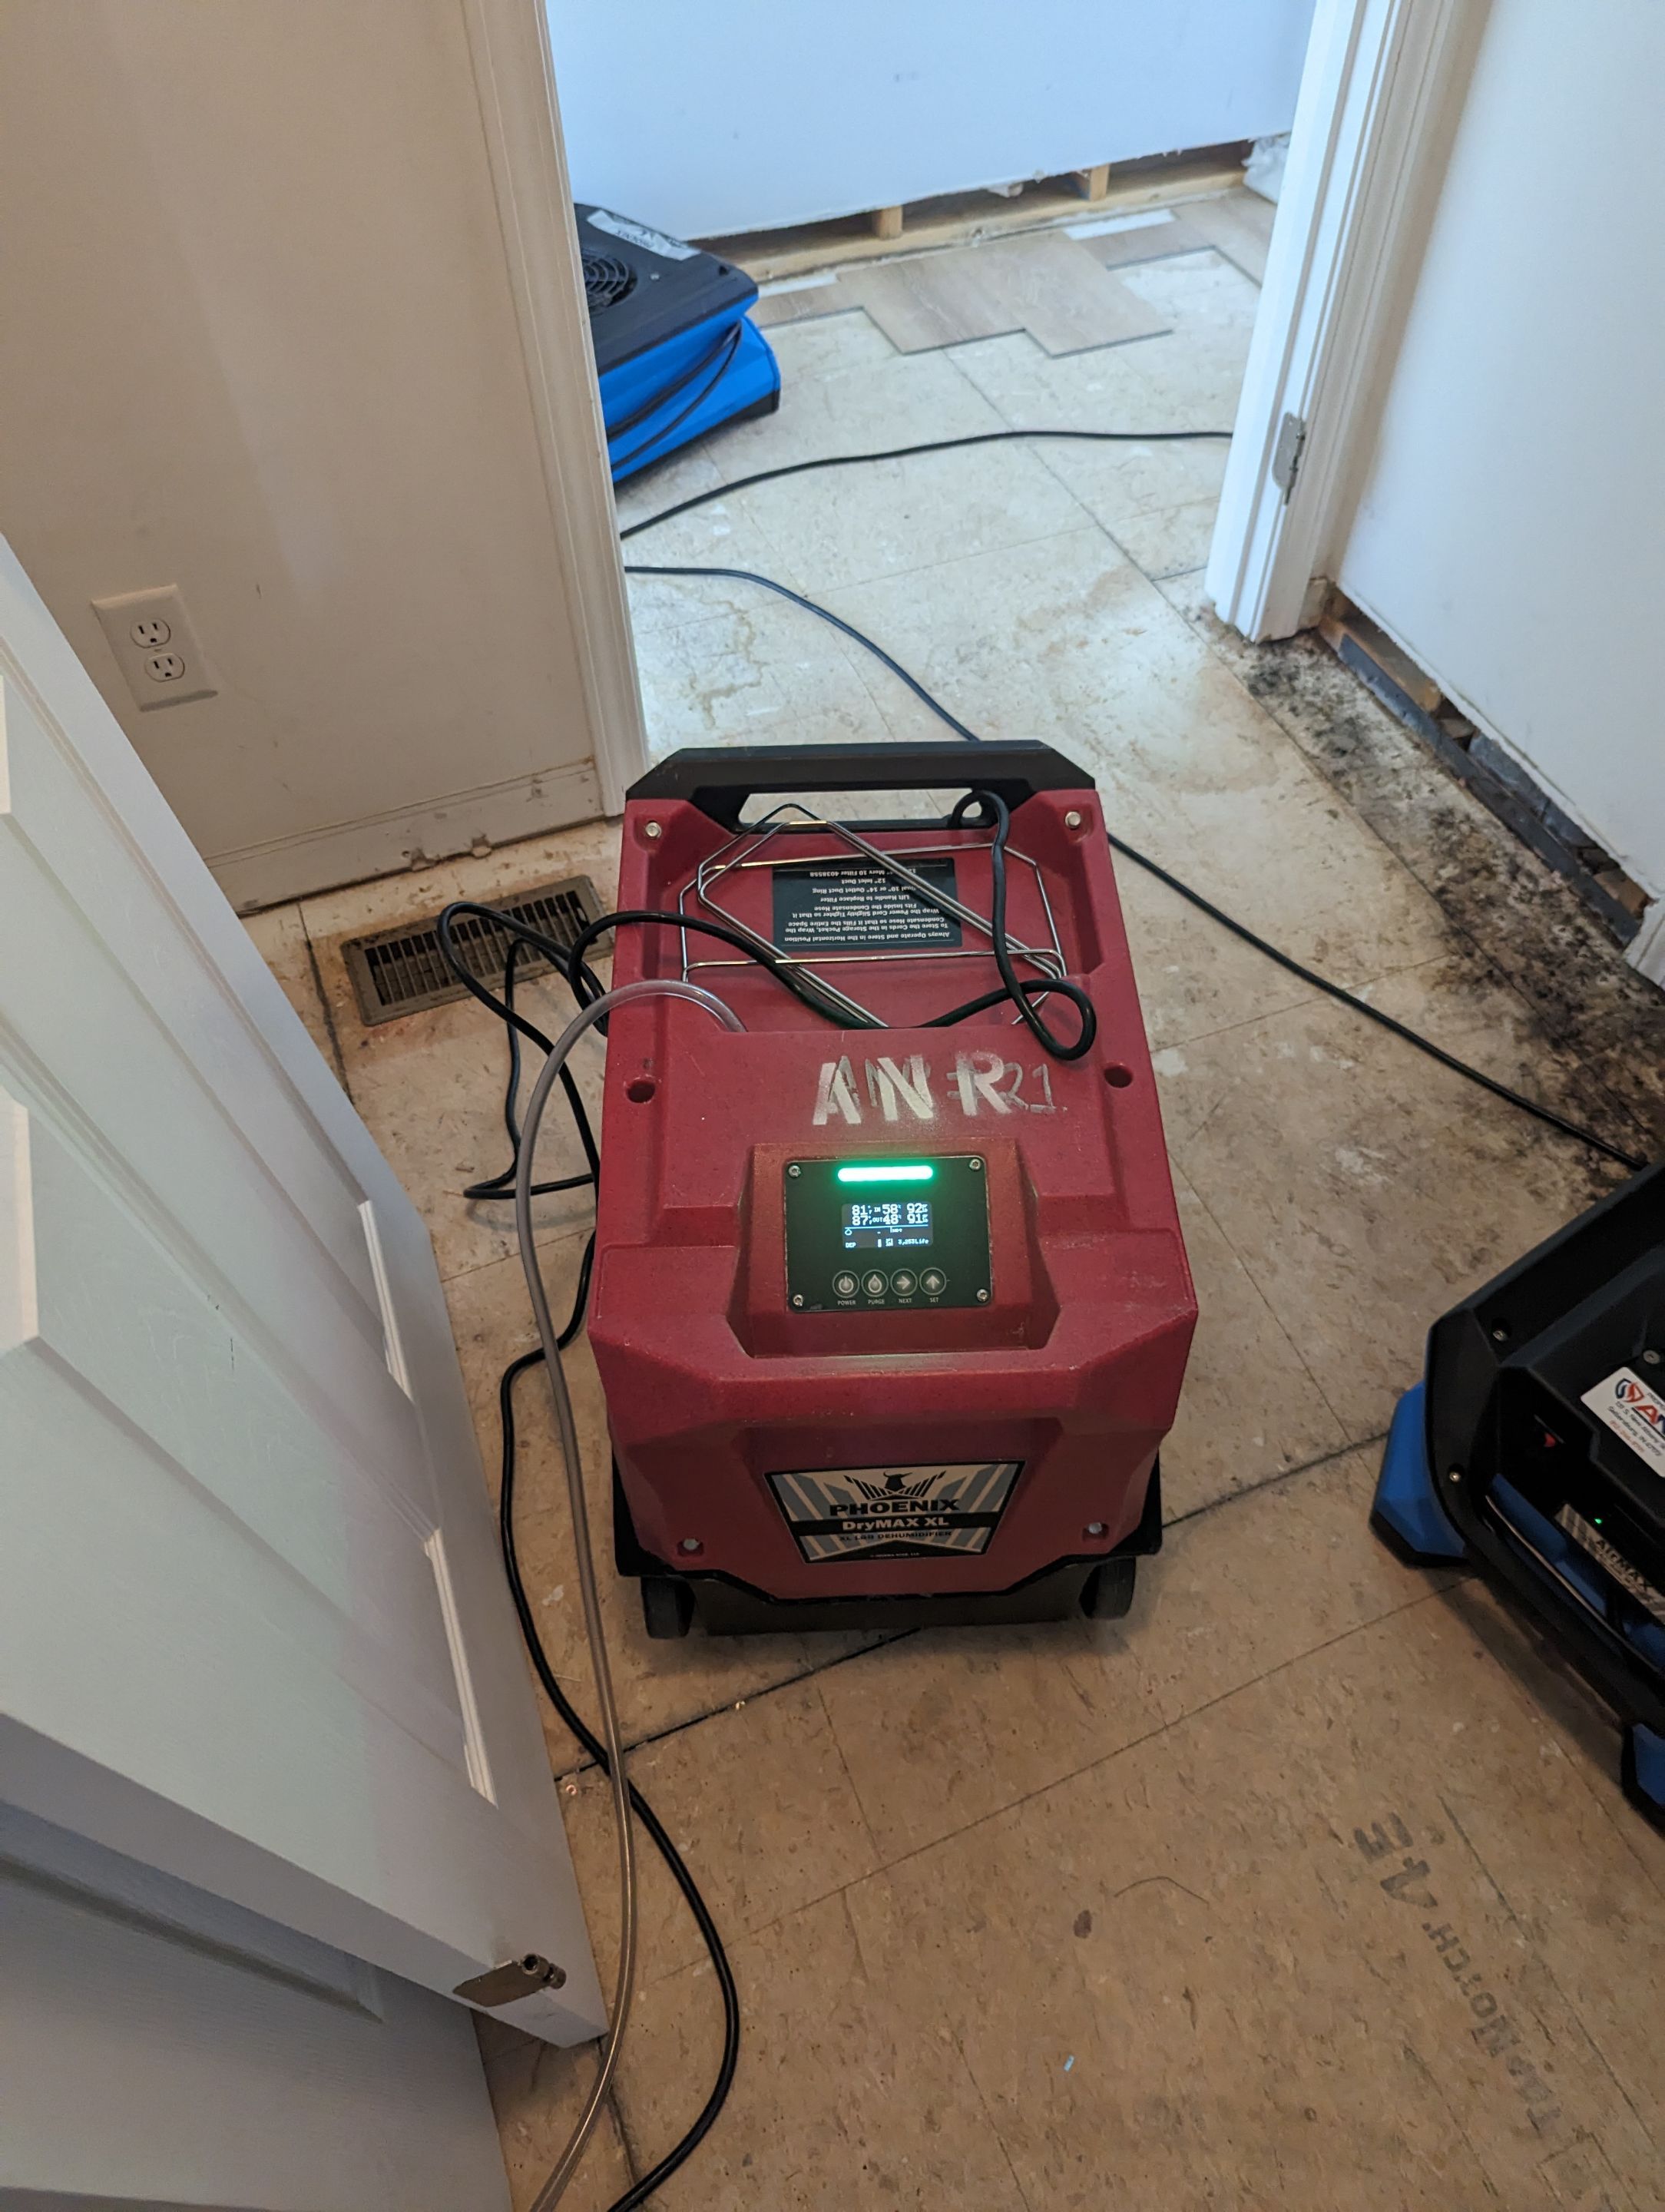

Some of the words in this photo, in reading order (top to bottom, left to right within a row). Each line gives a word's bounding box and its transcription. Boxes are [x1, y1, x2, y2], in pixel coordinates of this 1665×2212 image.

[829, 1498, 959, 1517] PHOENIX
[842, 1518, 920, 1532] DryMAX
[924, 1516, 949, 1526] XL
[877, 1531, 952, 1539] DEHUMIDIFIER
